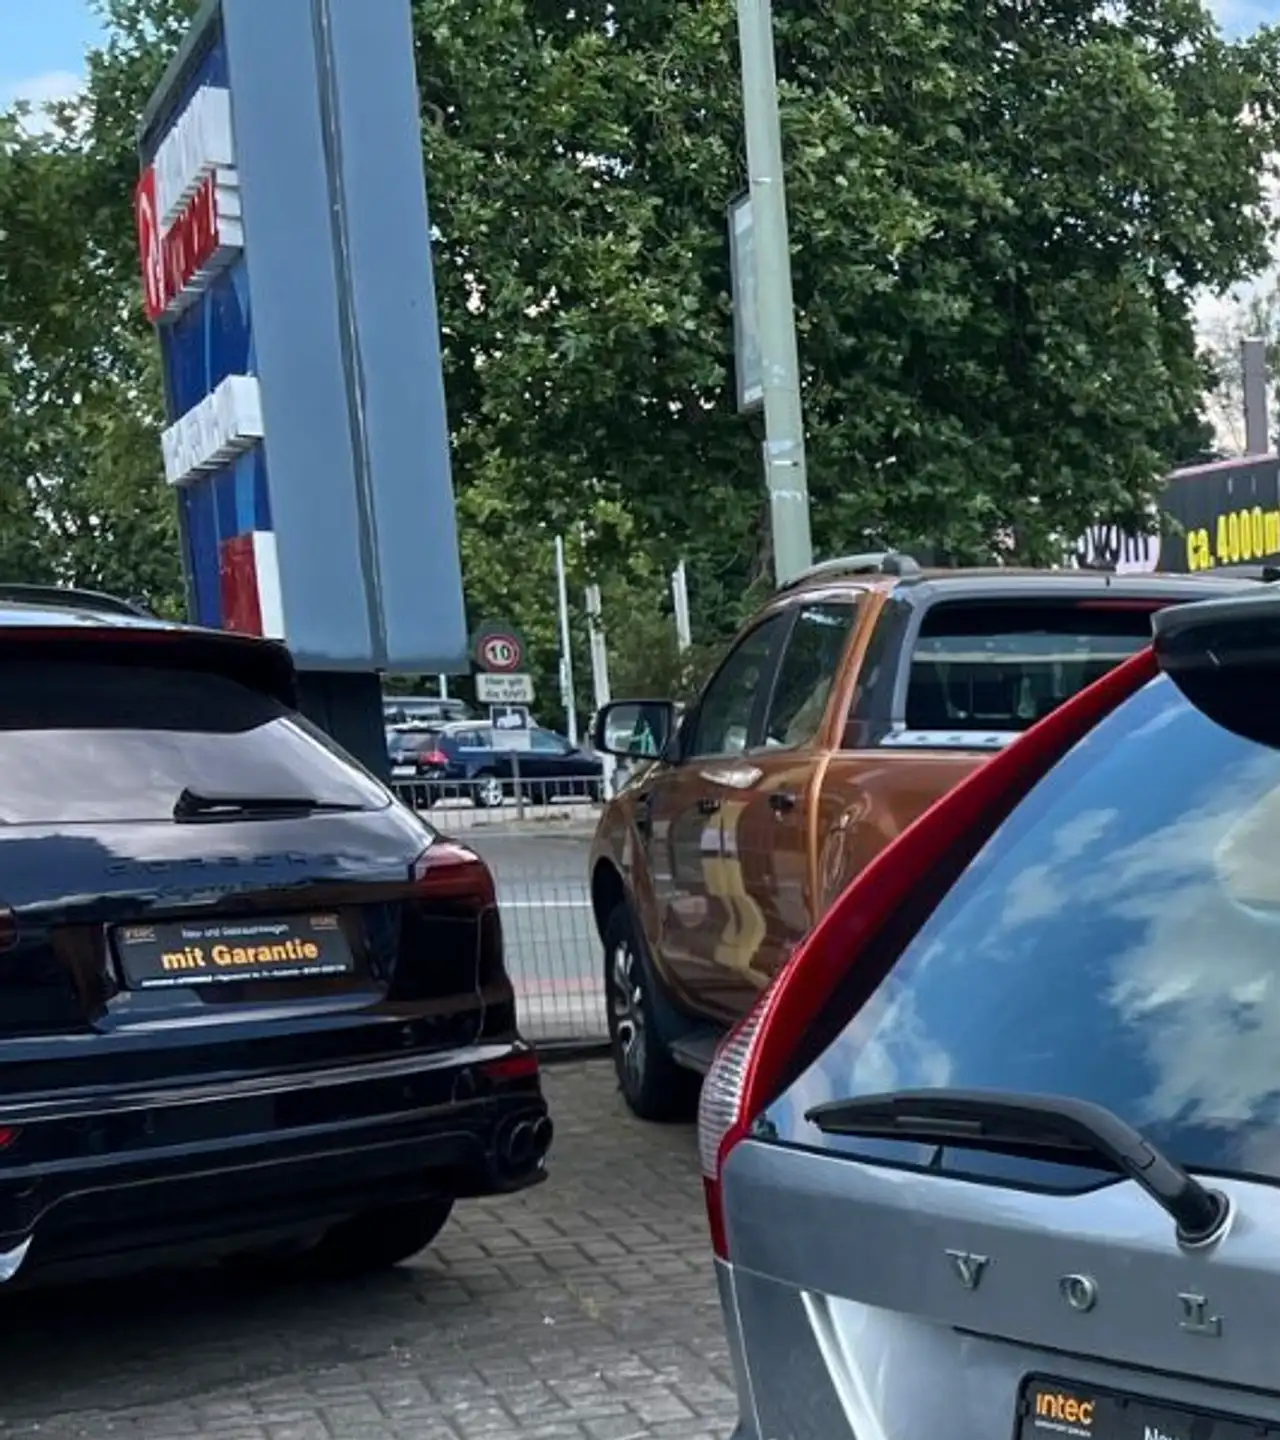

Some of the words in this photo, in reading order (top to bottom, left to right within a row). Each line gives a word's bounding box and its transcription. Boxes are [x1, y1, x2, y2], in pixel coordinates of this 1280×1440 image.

[1187, 528, 1215, 572] ca.
[489, 644, 511, 660] 10
[161, 945, 205, 971] mit
[211, 938, 318, 966] Garantie
[1036, 1392, 1093, 1425] intec
